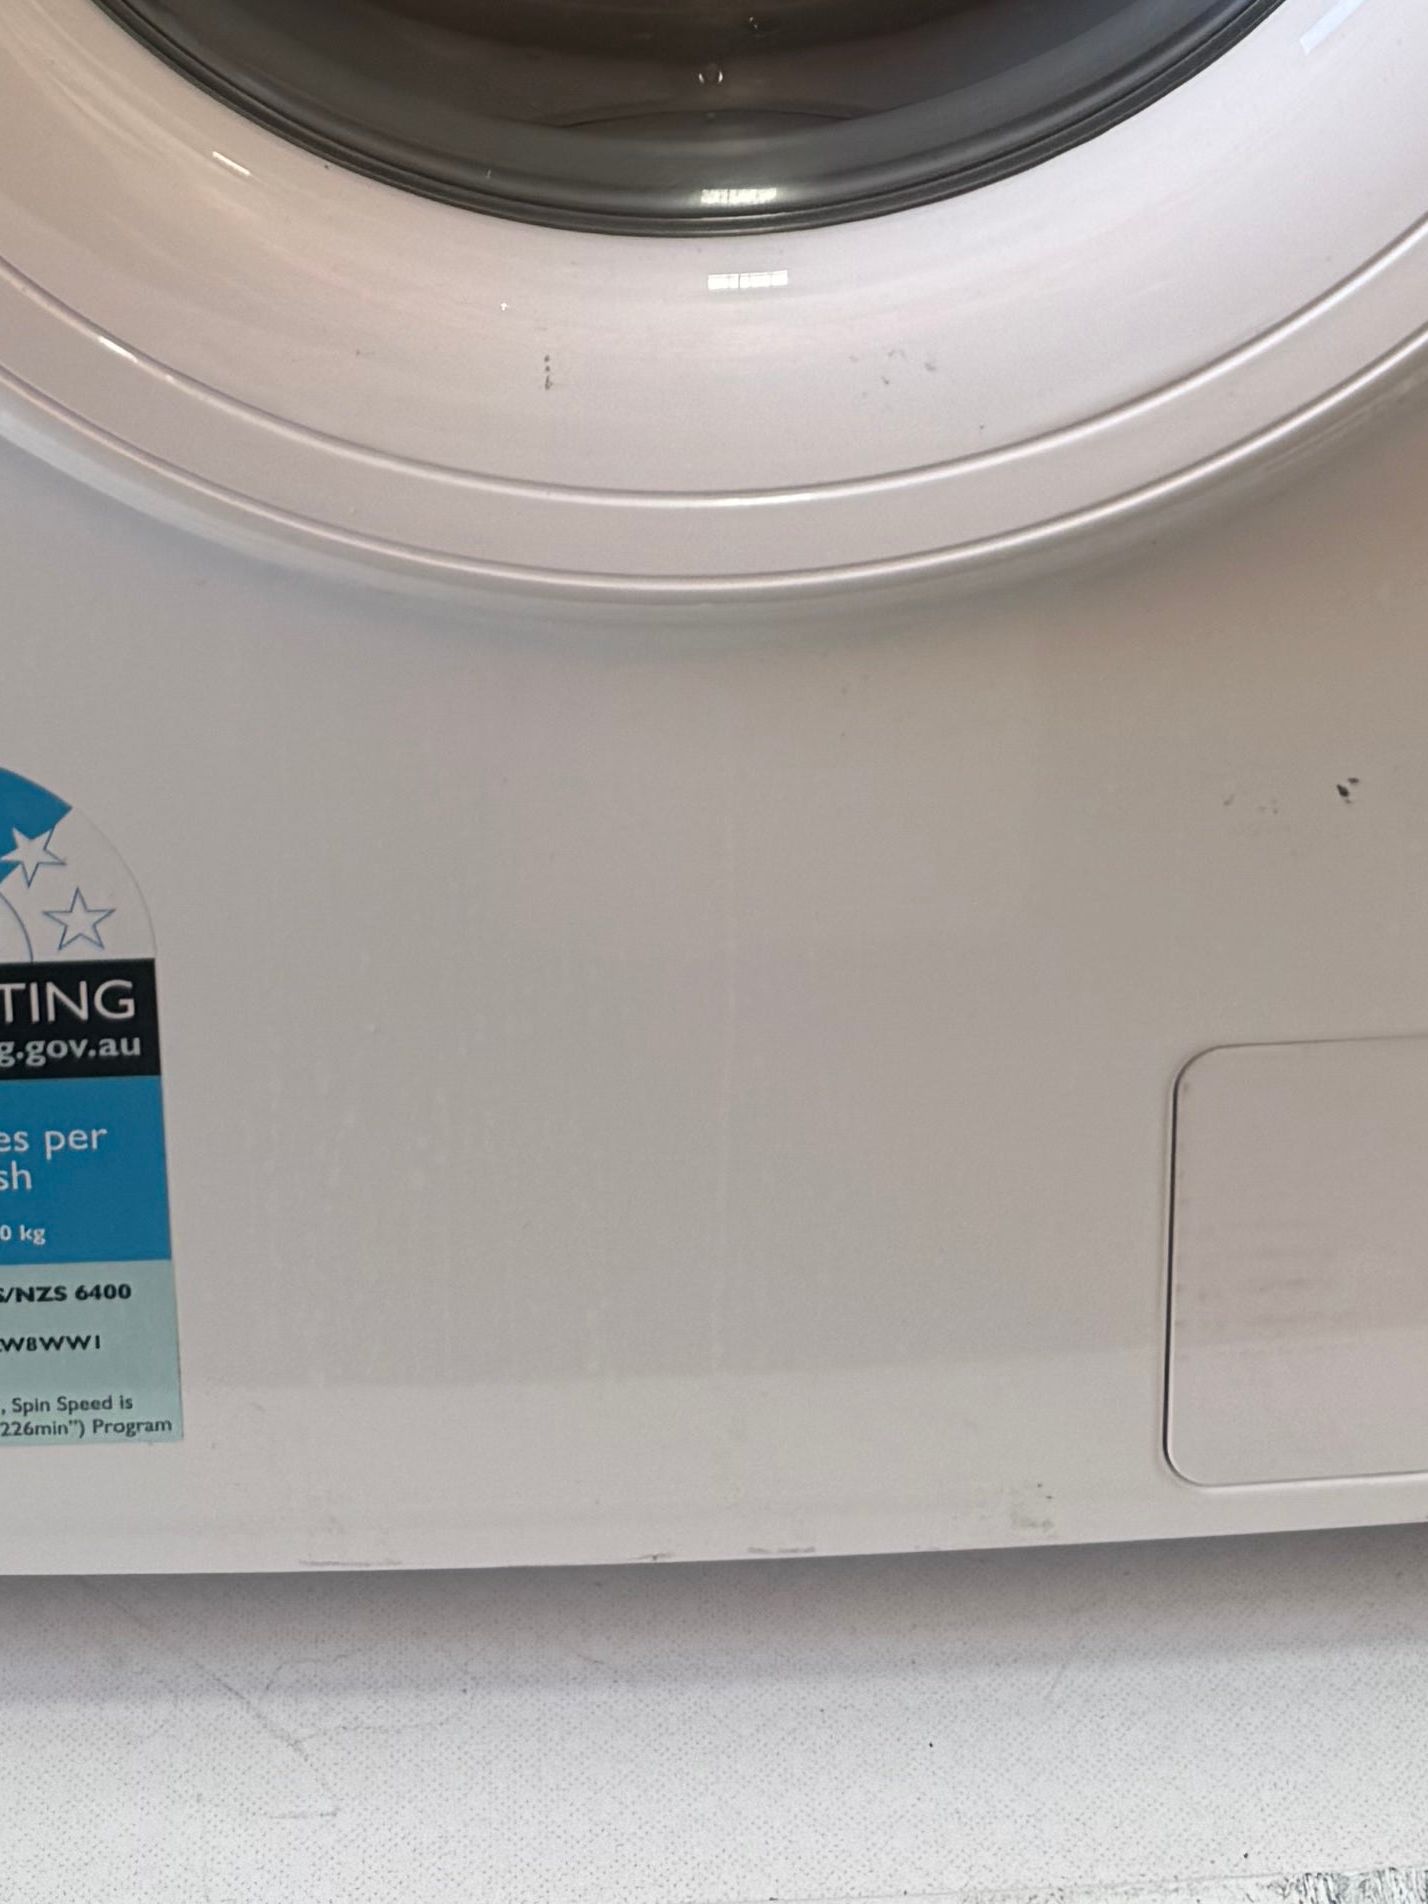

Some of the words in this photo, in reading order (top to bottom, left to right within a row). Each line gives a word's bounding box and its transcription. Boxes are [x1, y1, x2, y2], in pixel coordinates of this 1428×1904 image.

[45, 1129, 107, 1160] per
[20, 1225, 45, 1245] kg
[75, 1284, 131, 1300] 6400
[12, 1398, 50, 1417] Spin
[57, 1395, 112, 1415] Speed
[120, 1395, 133, 1409] is
[93, 1419, 172, 1437] Program
